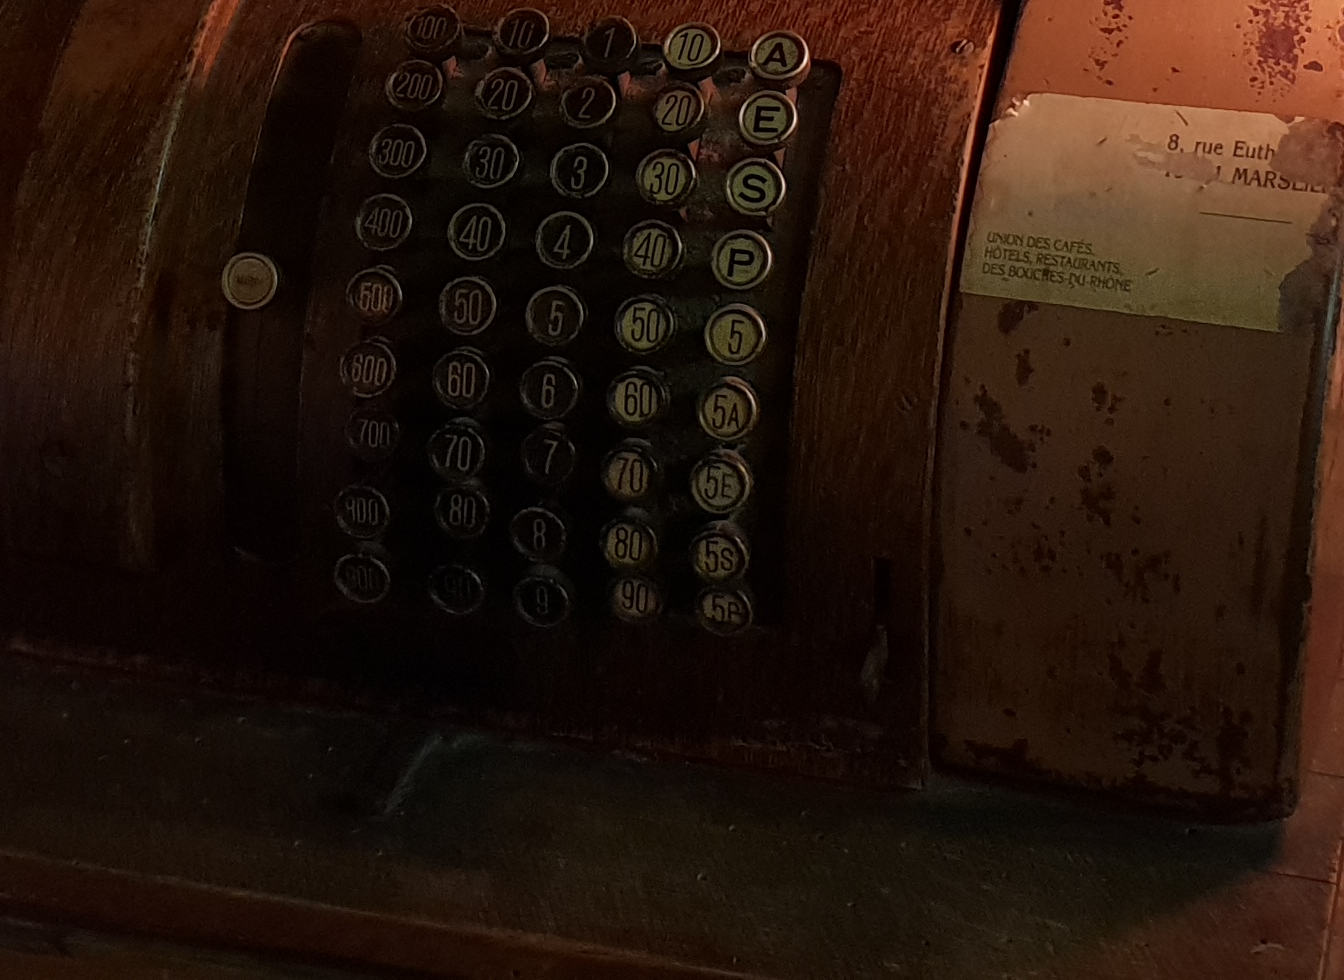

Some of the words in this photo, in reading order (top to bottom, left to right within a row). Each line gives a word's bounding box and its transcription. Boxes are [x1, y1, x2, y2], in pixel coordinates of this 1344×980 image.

[417, 15, 448, 40] 100
[509, 18, 534, 49] 10
[602, 26, 616, 59] 1
[678, 30, 706, 63] 10
[763, 43, 788, 68] A
[396, 72, 433, 101] 200
[487, 78, 518, 111] 20
[578, 87, 596, 119] 2
[661, 94, 692, 127] 20
[754, 106, 781, 132] E
[377, 136, 415, 169] 300
[477, 144, 505, 177] 30
[1194, 140, 1224, 156] rue
[1233, 140, 1276, 161] Euth
[570, 156, 586, 190] 3
[652, 161, 679, 196] 30
[738, 175, 767, 201] S
[364, 207, 403, 237] 400
[459, 216, 492, 250] 40
[553, 225, 572, 260] 4
[633, 230, 667, 265] 40
[987, 231, 1023, 247] UNION
[1027, 236, 1050, 251] DES
[728, 248, 755, 276] P
[982, 262, 1006, 276] DES
[454, 289, 482, 325] 50
[549, 301, 565, 336] 5
[631, 304, 660, 338] 50
[727, 319, 744, 355] 5
[351, 353, 388, 386] 600
[447, 361, 476, 398] 60
[541, 373, 555, 408] 6
[624, 381, 653, 418] 60
[711, 394, 740, 430] 5A
[356, 418, 390, 448] 700
[444, 433, 472, 471] 70
[542, 437, 556, 476] 7
[617, 457, 644, 493] 70
[704, 465, 733, 500] 5E
[449, 493, 477, 528] 80
[533, 518, 547, 549] 8
[614, 527, 643, 561] 80
[705, 540, 734, 573] 5S
[536, 589, 549, 615] 9
[622, 581, 649, 613] 90
